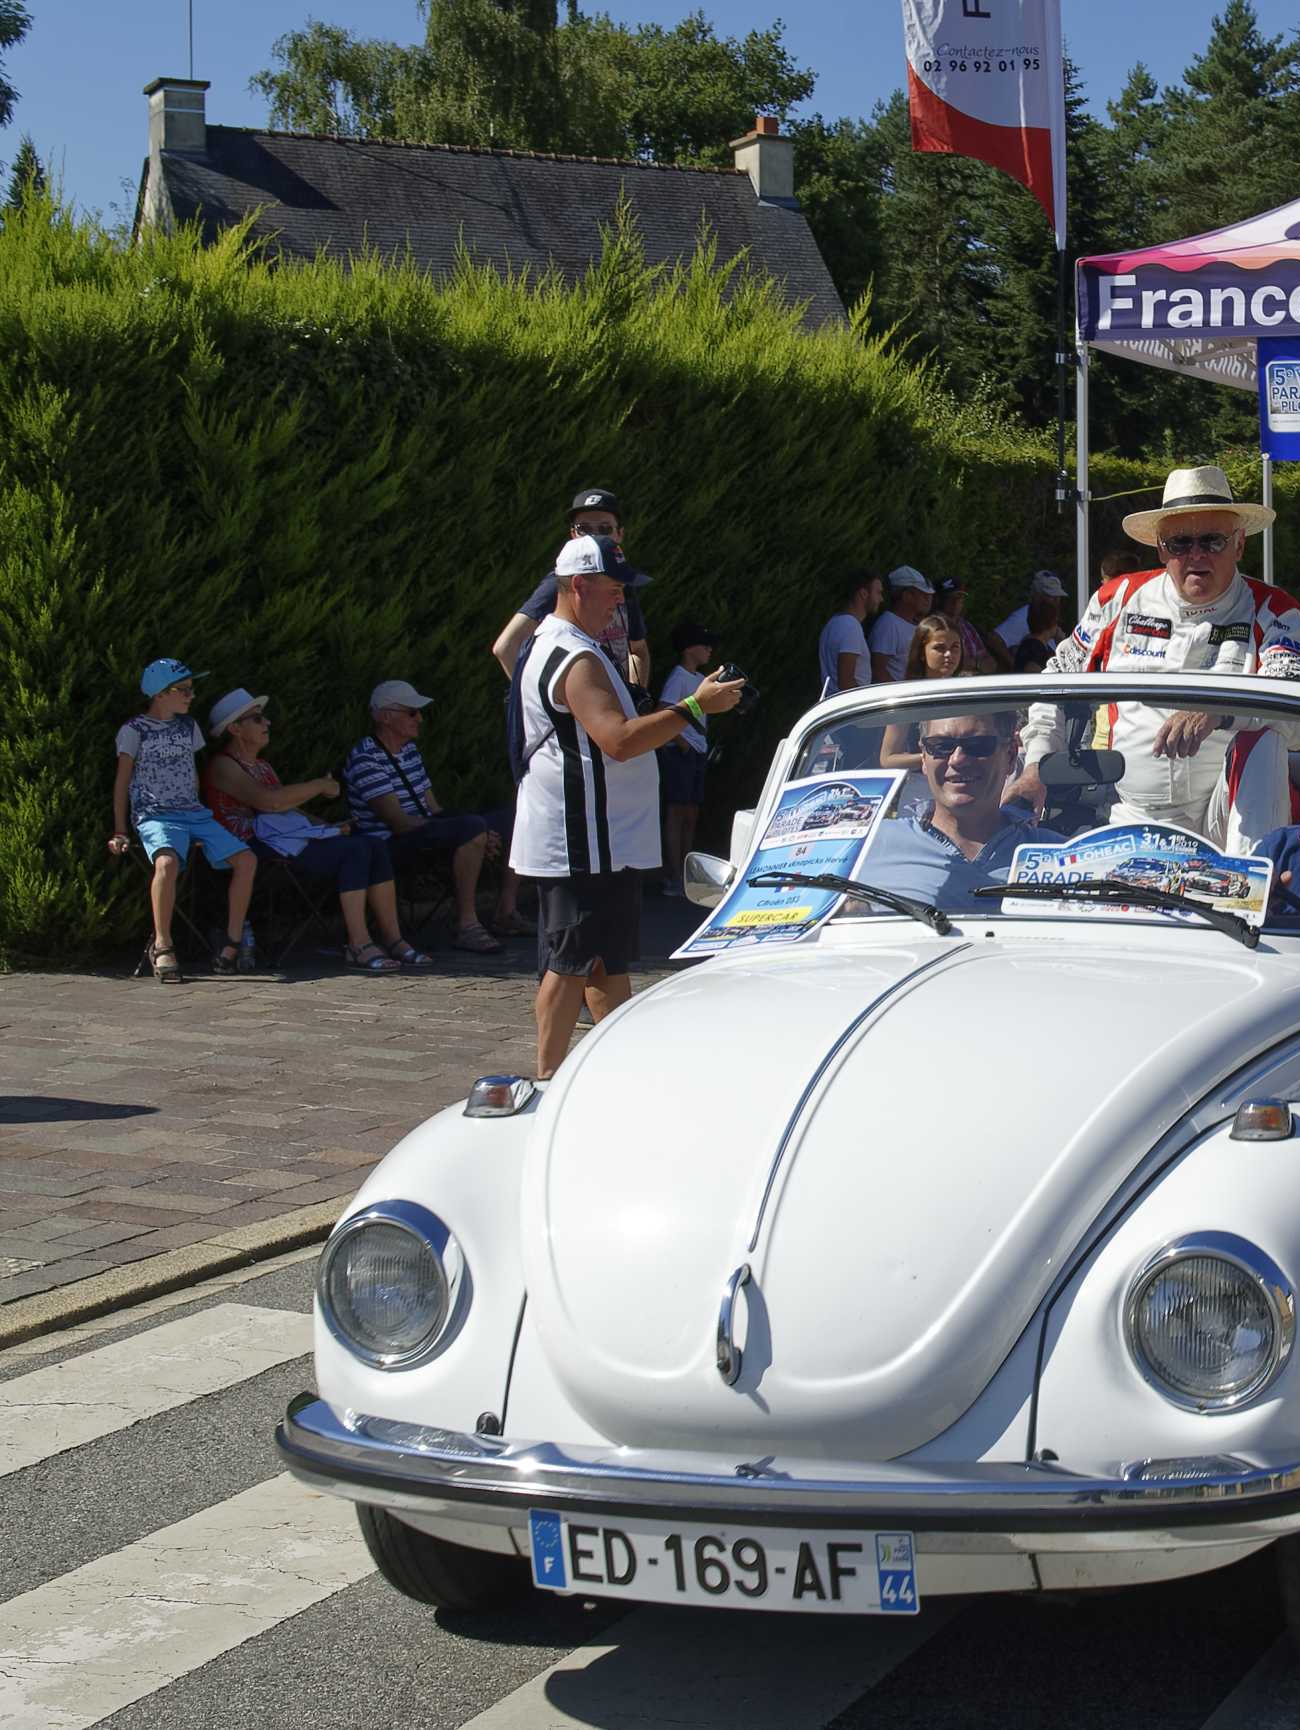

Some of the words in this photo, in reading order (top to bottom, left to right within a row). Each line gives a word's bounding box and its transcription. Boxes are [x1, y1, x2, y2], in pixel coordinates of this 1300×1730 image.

[936, 43, 1039, 59] Contactez-nous
[924, 61, 942, 72] 02
[949, 60, 967, 72] 96
[974, 61, 991, 73] 92
[999, 61, 1015, 72] 01
[1024, 58, 1040, 70] 95
[1077, 841, 1130, 862] LOHEAC
[1016, 871, 1094, 884] PARADE
[737, 911, 800, 923] SUPERCAR
[543, 1557, 554, 1574] F
[566, 1523, 863, 1601] ED-169-AF
[882, 1575, 914, 1604] 44
